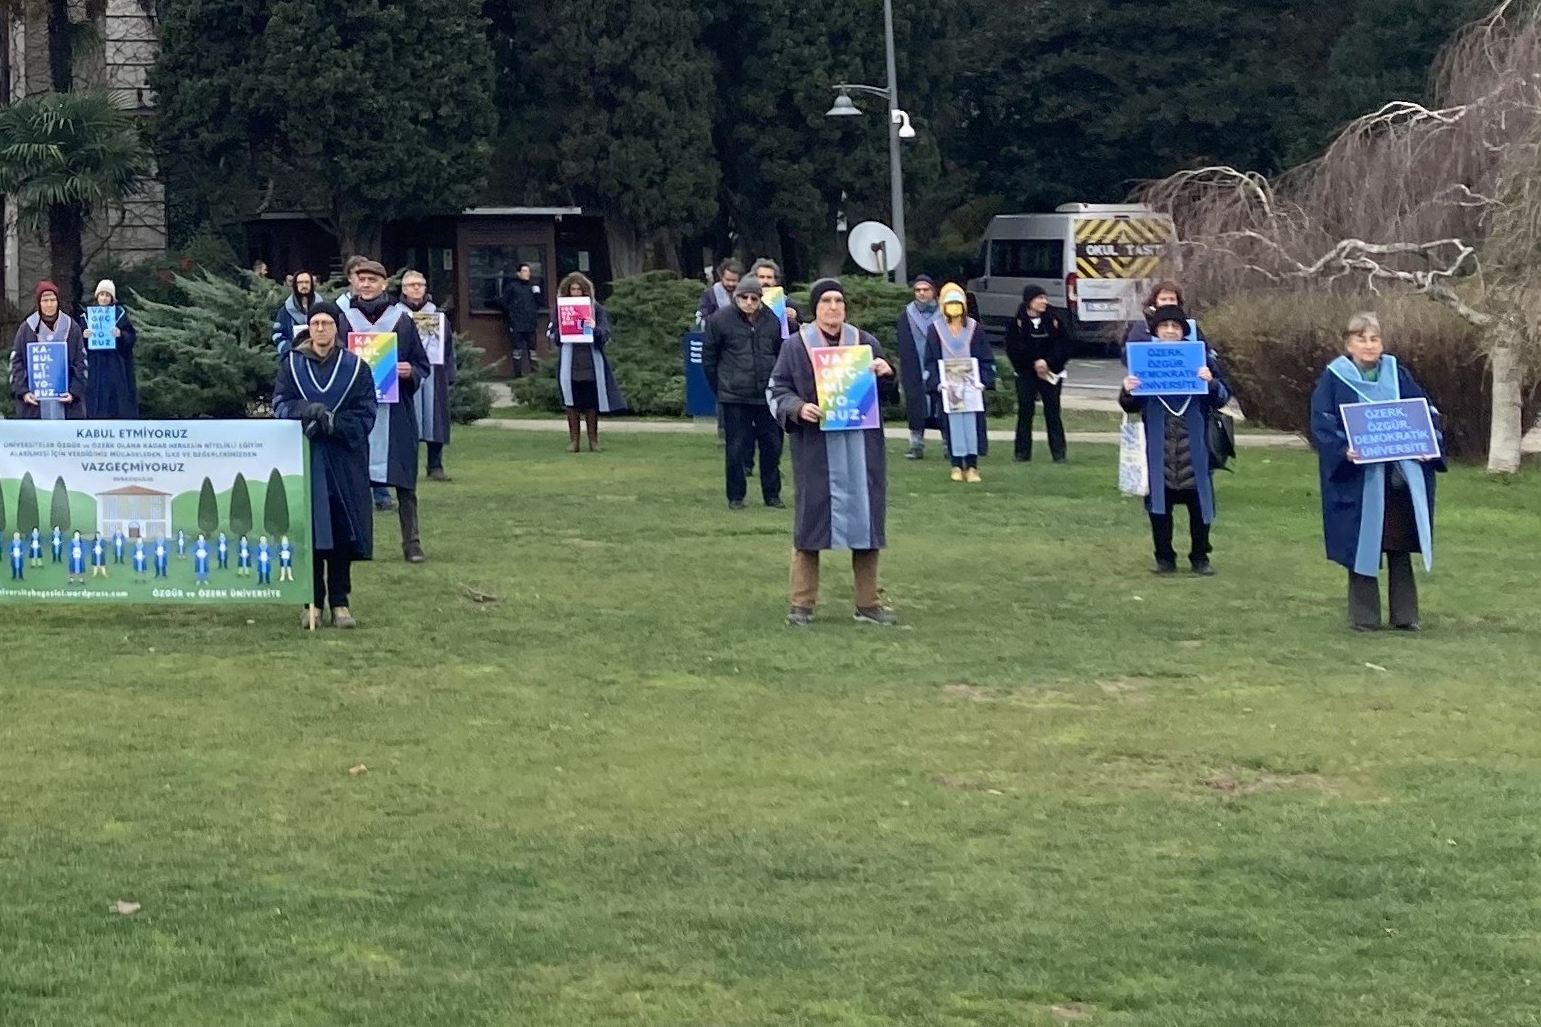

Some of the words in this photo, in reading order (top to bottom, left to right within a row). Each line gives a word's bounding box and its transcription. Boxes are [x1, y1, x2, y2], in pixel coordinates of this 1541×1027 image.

[1086, 244, 1118, 256] OKUL
[32, 346, 51, 354] KA-
[32, 354, 54, 362] BUL
[819, 353, 861, 365] VAZ-
[822, 367, 864, 379] GEÇ-
[34, 380, 52, 388] YO-
[826, 395, 855, 407] YO-
[826, 408, 866, 421] RUZ.
[1365, 407, 1408, 419] ÖZERK,
[77, 429, 115, 438] KABUL
[119, 426, 188, 439] ETMİYORUZ
[1354, 430, 1429, 445] DEMOKRATİK
[1361, 442, 1428, 457] ÜNİVERSİTE
[82, 460, 185, 473] VAZGEÇMİYORUZ
[153, 588, 183, 598] ÖZGÜR
[198, 588, 227, 598] ÖZERK
[230, 587, 281, 598] ÜNİVERSİTE
